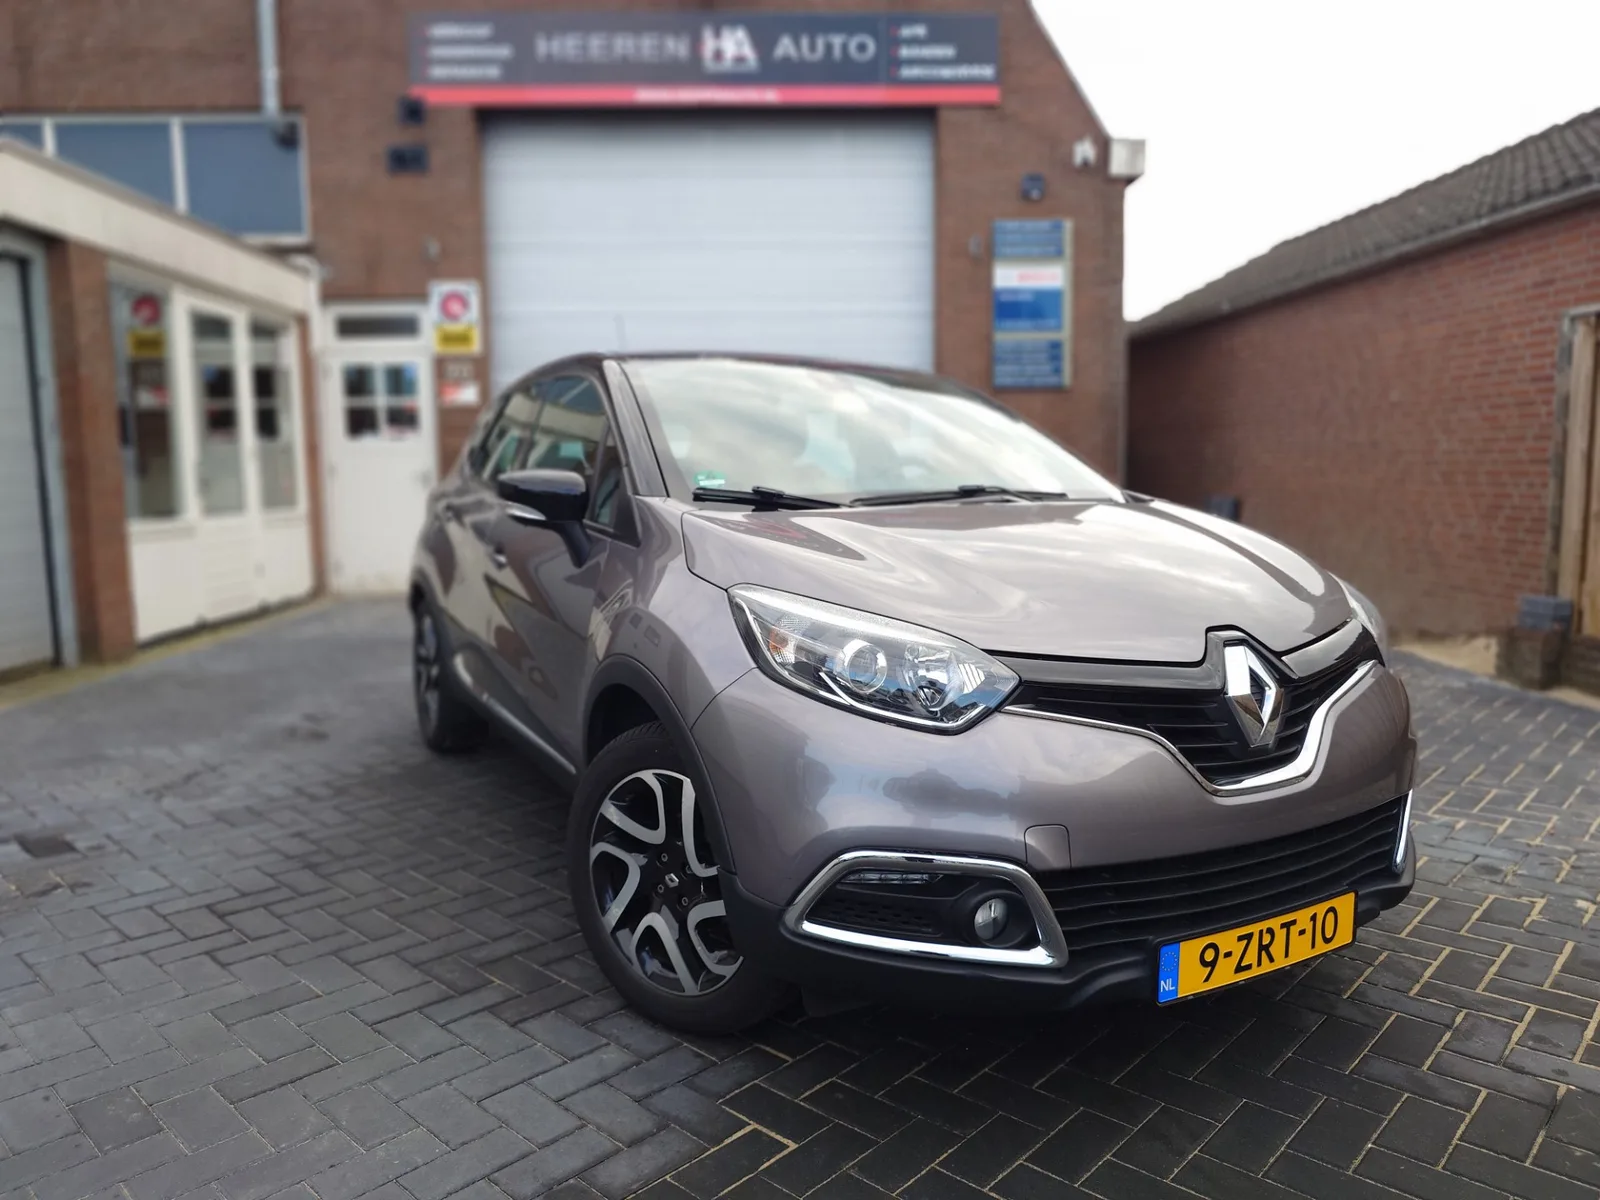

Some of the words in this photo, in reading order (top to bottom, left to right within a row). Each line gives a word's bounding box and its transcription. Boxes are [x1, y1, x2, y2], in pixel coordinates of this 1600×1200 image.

[535, 33, 690, 62] HEEREN
[773, 33, 877, 62] AUTO
[1199, 905, 1339, 984] 9-ZRT-10
[1160, 978, 1176, 993] NL
